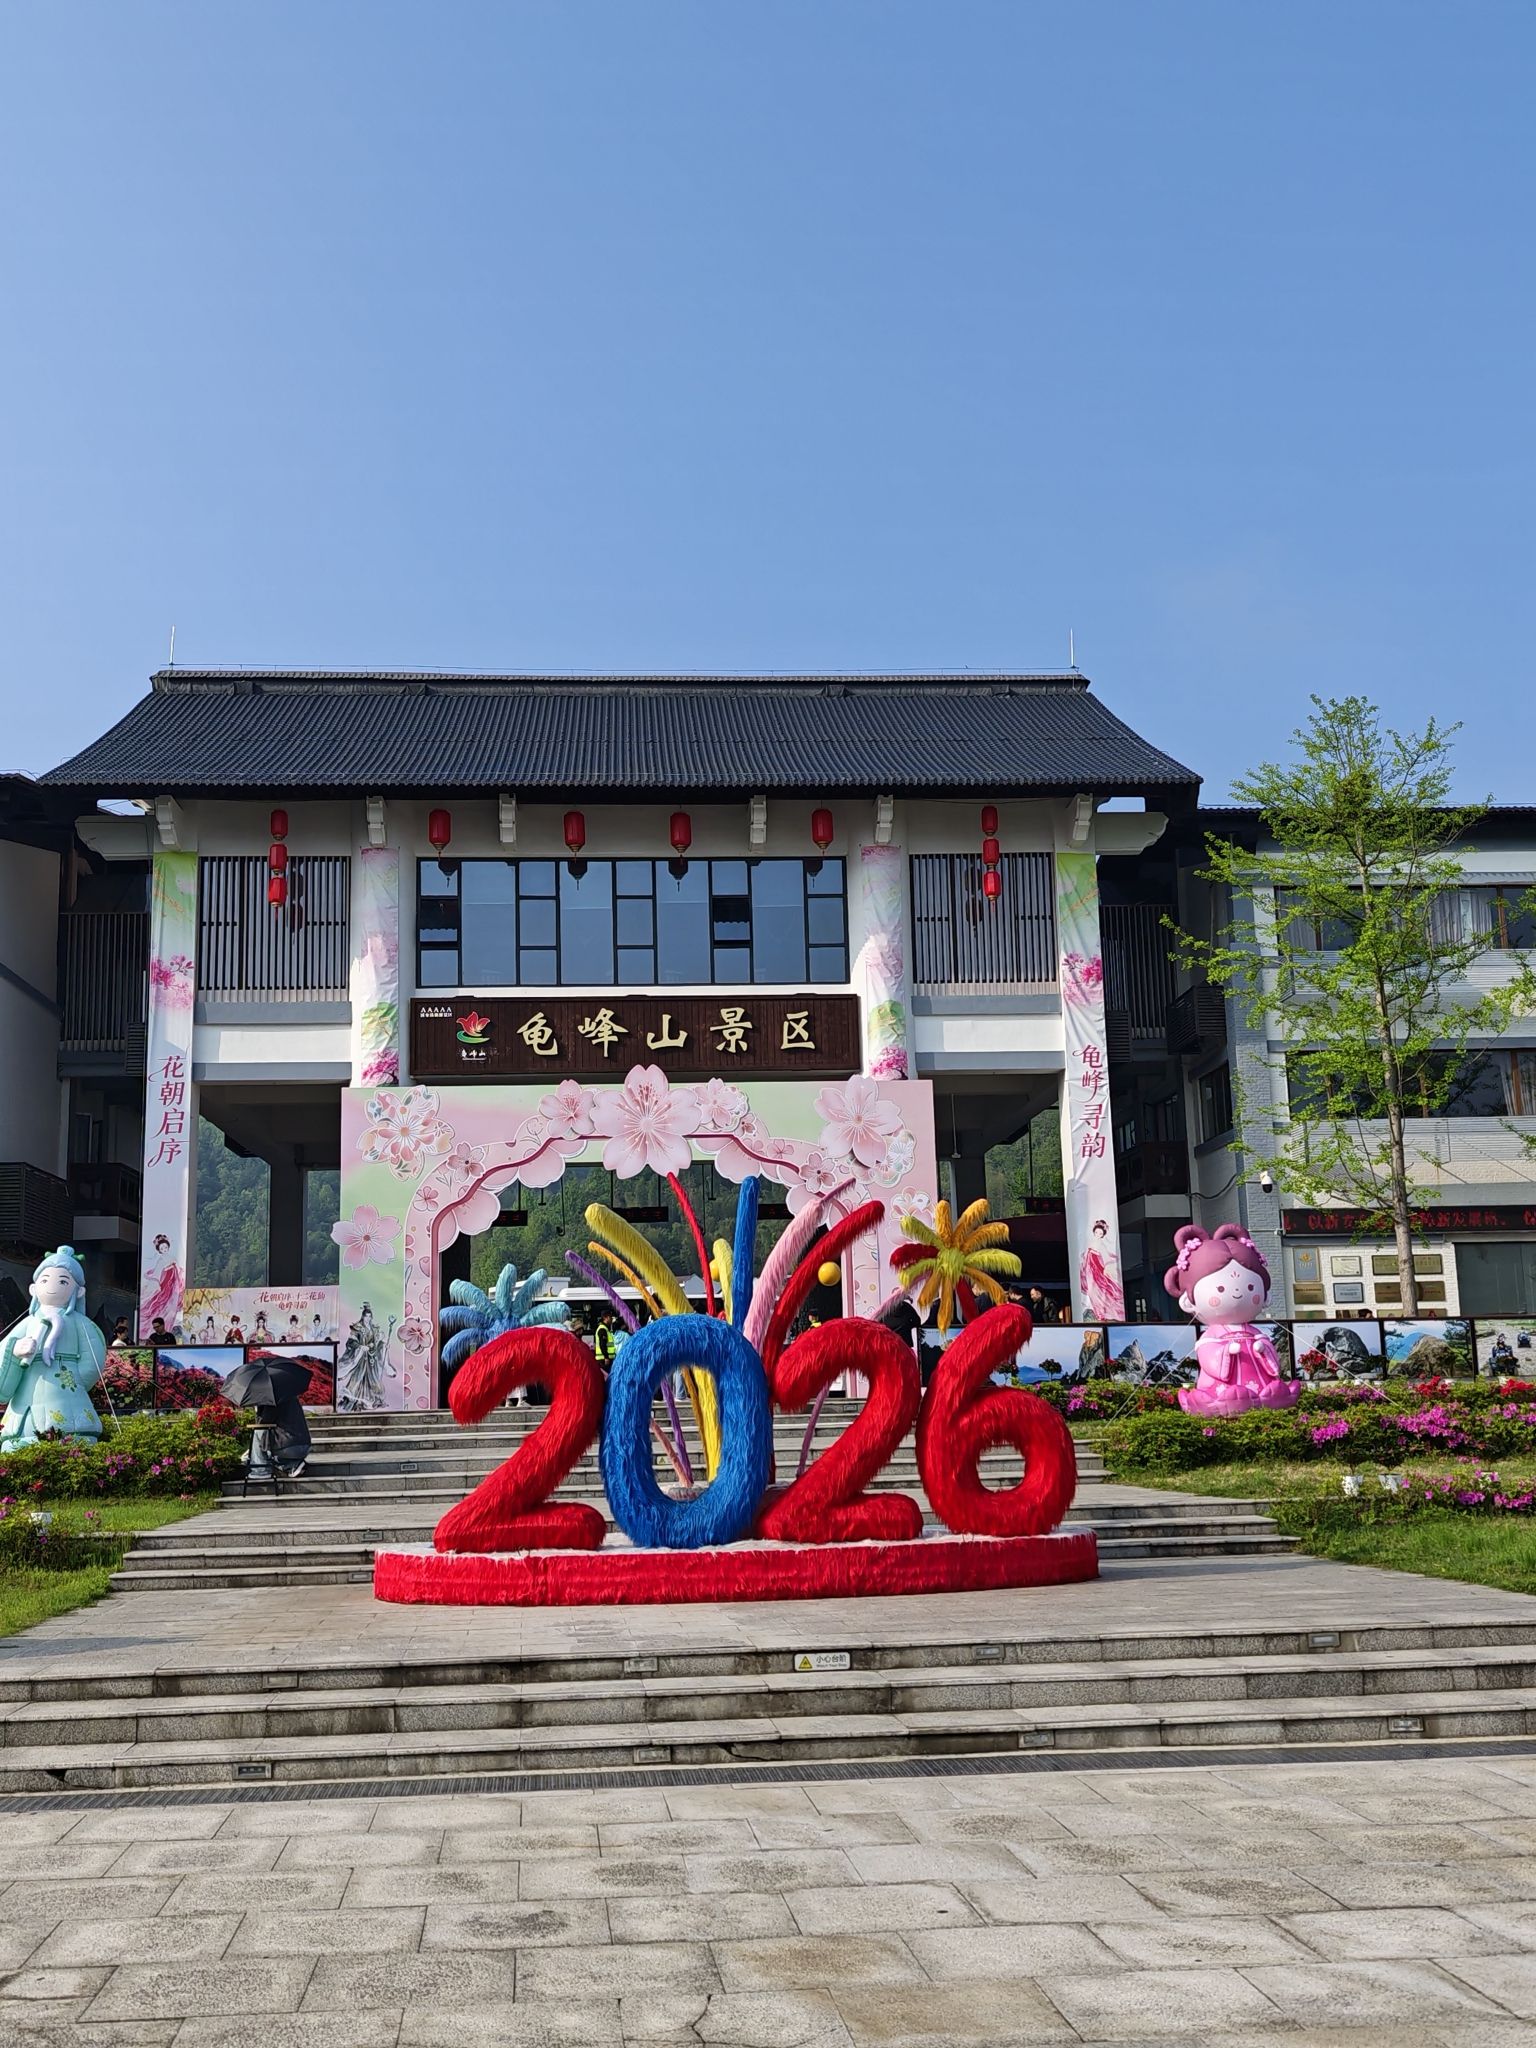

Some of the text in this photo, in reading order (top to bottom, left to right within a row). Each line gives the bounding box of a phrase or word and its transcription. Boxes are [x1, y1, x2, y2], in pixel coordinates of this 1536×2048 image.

[516, 1007, 816, 1057] 龟峰山景区
[148, 1055, 189, 1168] 花朝启序
[1072, 1044, 1106, 1158] 龟峰寻韵
[432, 1301, 1078, 1554] 2026
